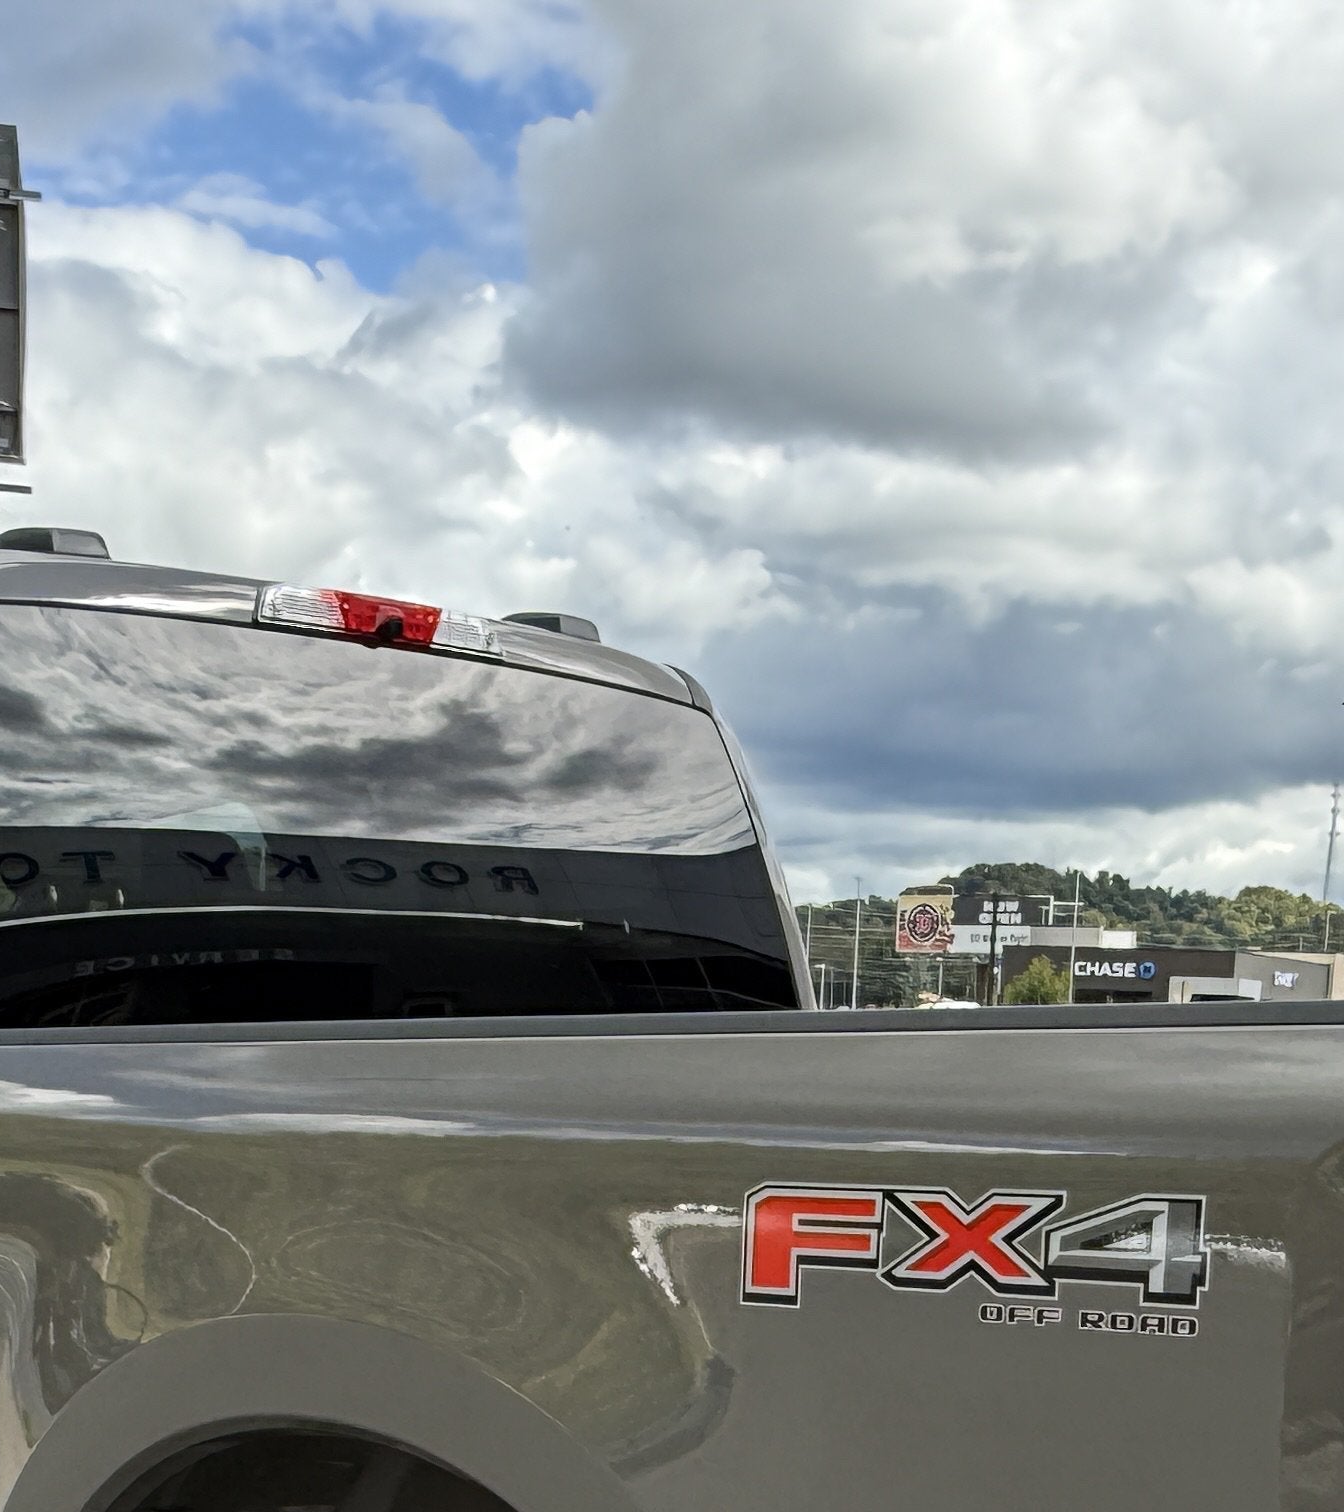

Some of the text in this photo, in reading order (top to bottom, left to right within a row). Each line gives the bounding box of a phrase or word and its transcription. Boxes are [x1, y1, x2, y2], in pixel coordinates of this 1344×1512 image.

[1074, 961, 1137, 978] CHASE
[740, 1181, 1208, 1309] FX4
[978, 1303, 1199, 1337] OFF ROAD
